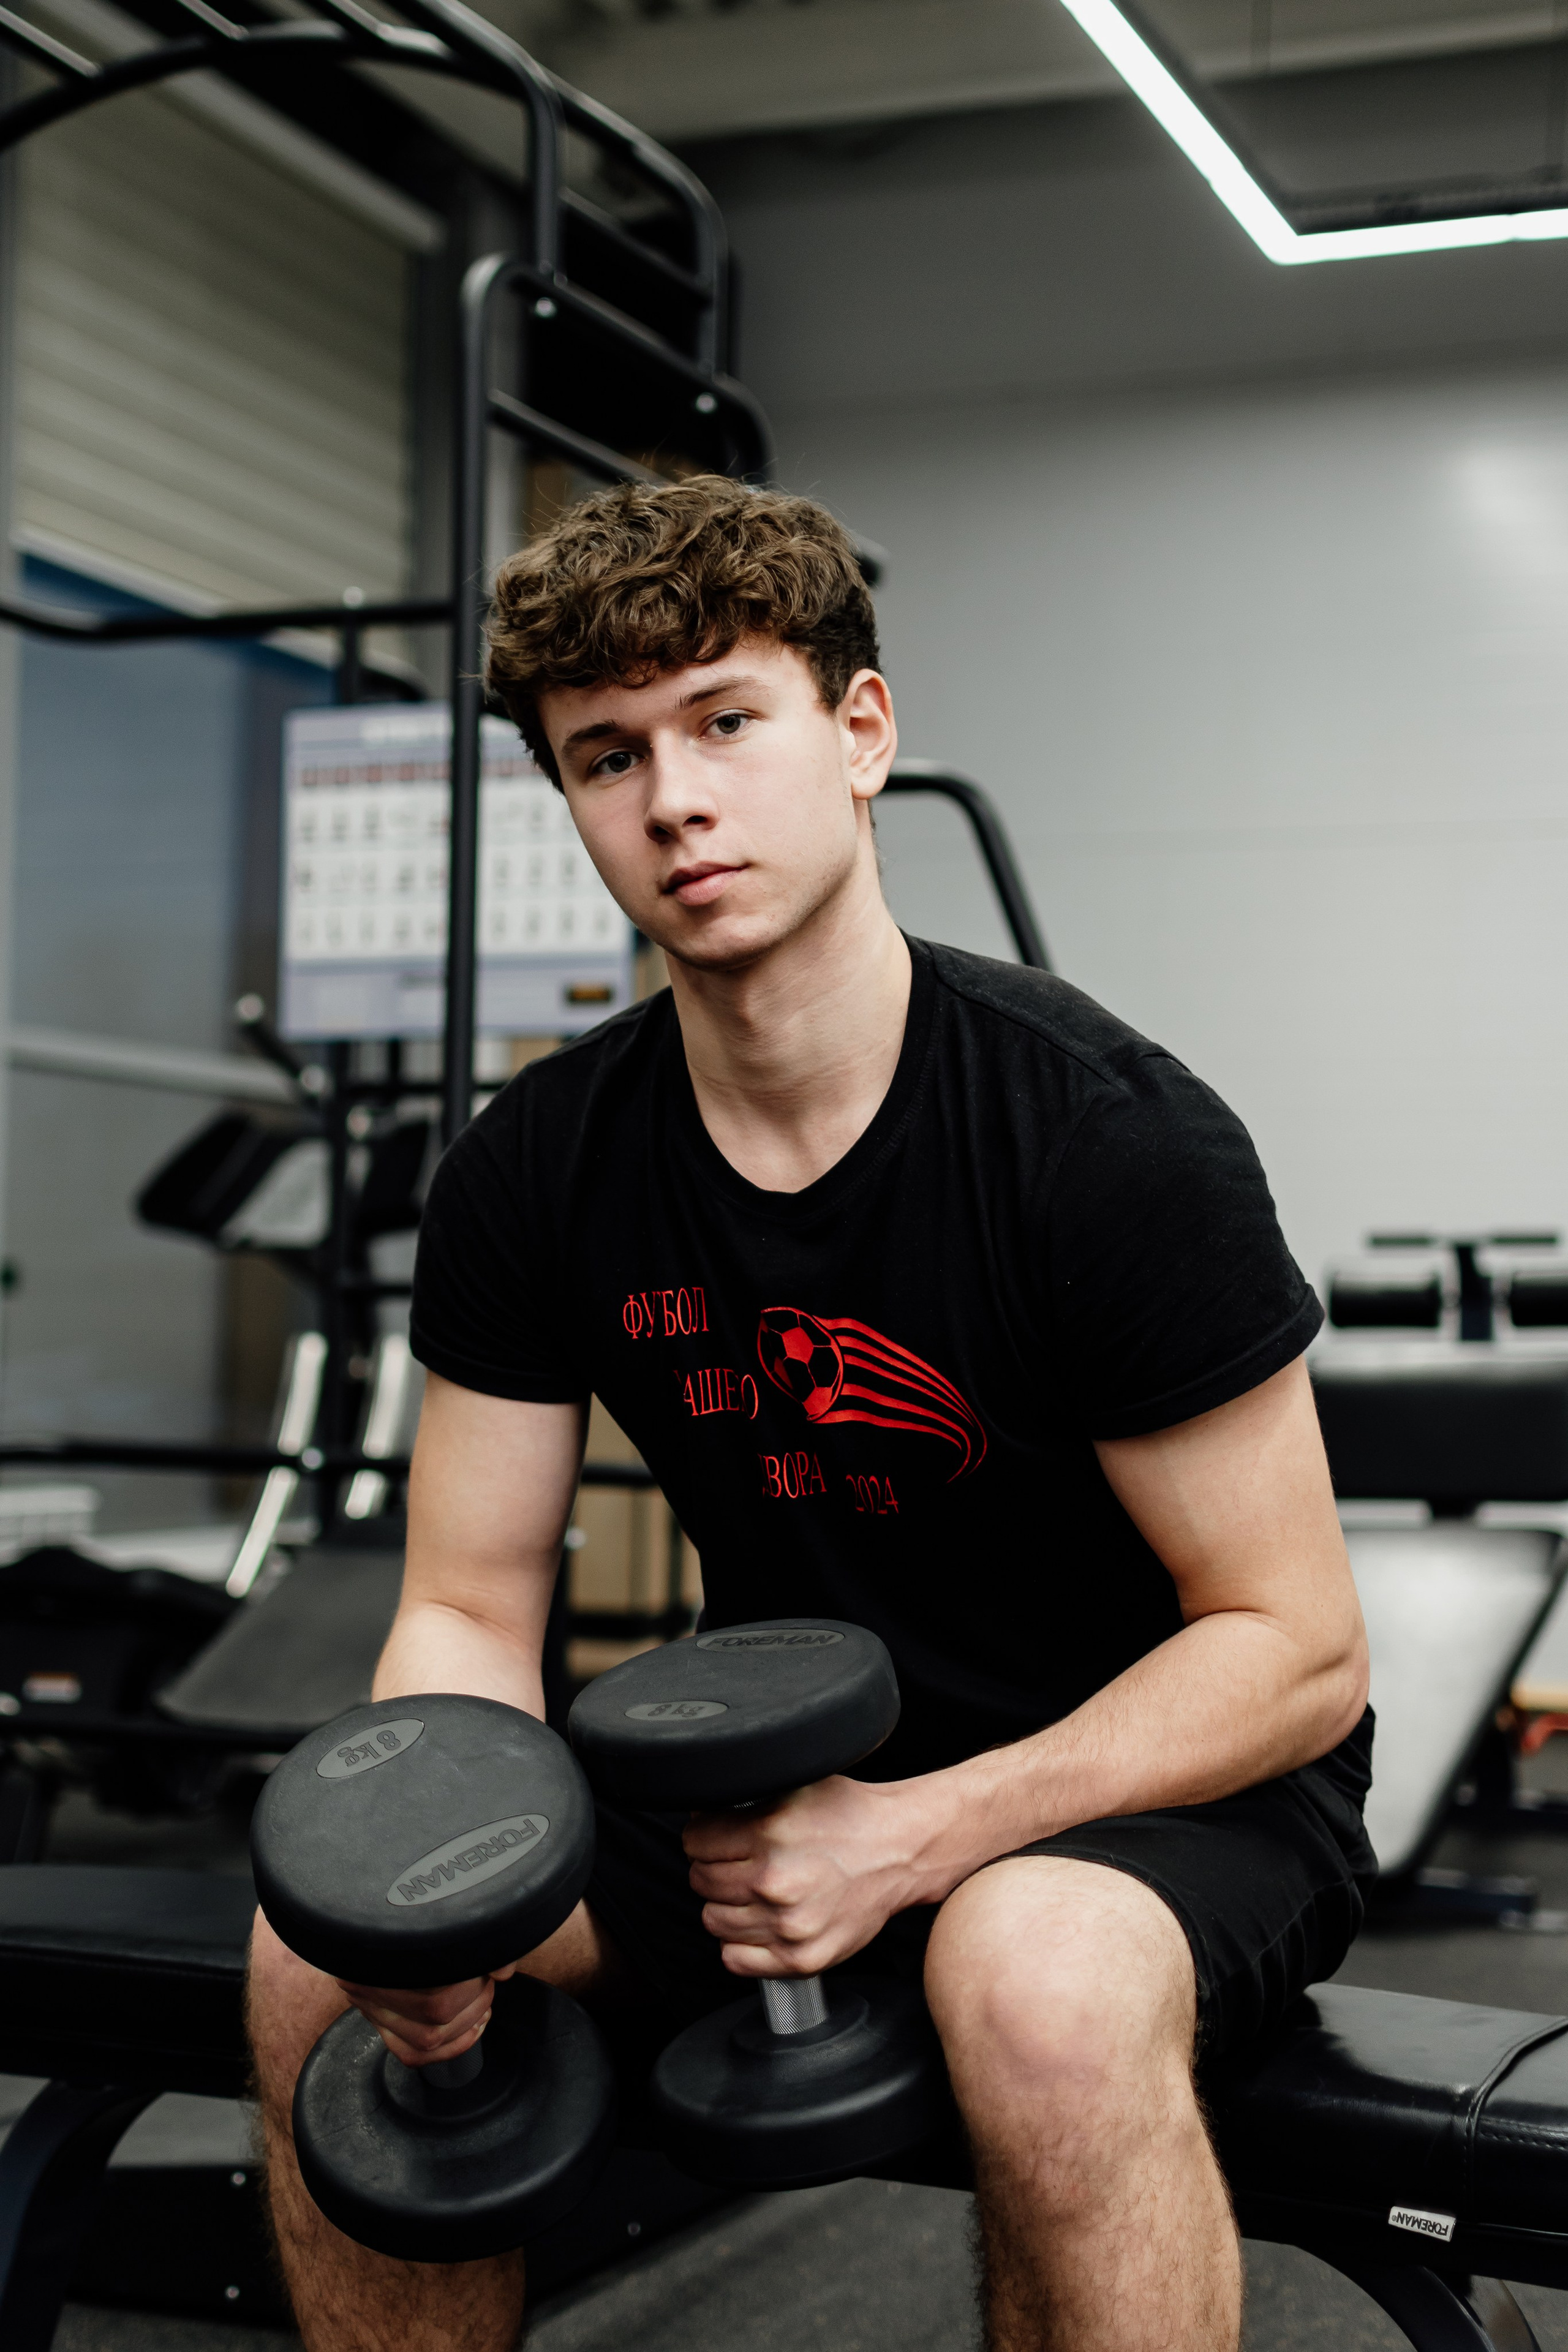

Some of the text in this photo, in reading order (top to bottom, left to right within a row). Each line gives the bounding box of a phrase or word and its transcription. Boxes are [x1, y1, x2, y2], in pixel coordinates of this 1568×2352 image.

[622, 1286, 710, 1340] ФУБОЛ
[672, 1368, 760, 1420] АШЕО
[845, 1474, 899, 1515] 2024
[708, 1633, 834, 1648] FOREMAN
[337, 1729, 402, 1768] 8 kg
[396, 1817, 541, 1902] FOREMAN
[1396, 2211, 1449, 2236] FOREMAN
